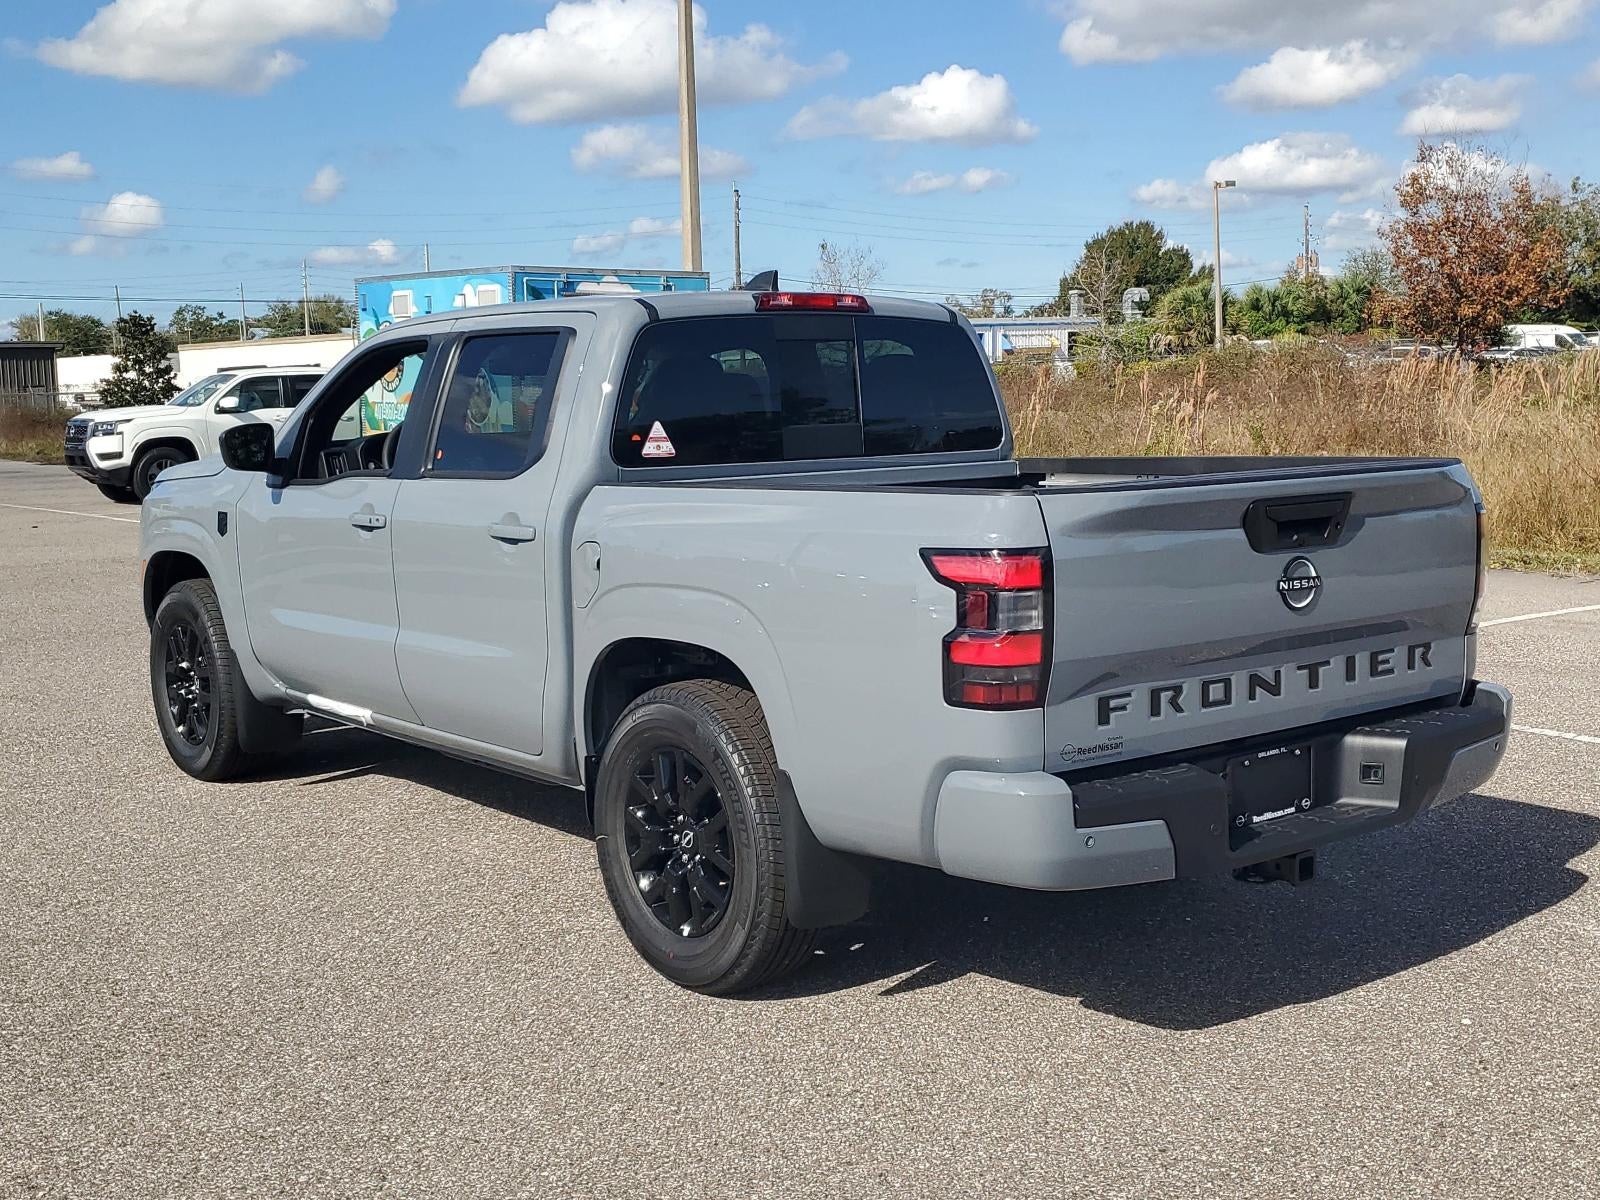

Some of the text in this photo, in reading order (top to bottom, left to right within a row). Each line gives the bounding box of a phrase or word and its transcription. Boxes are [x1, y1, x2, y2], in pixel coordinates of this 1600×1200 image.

[1279, 578, 1321, 590] NISSAN
[1097, 641, 1433, 727] FRONTIER
[1252, 806, 1296, 823] ReedNissan.com
